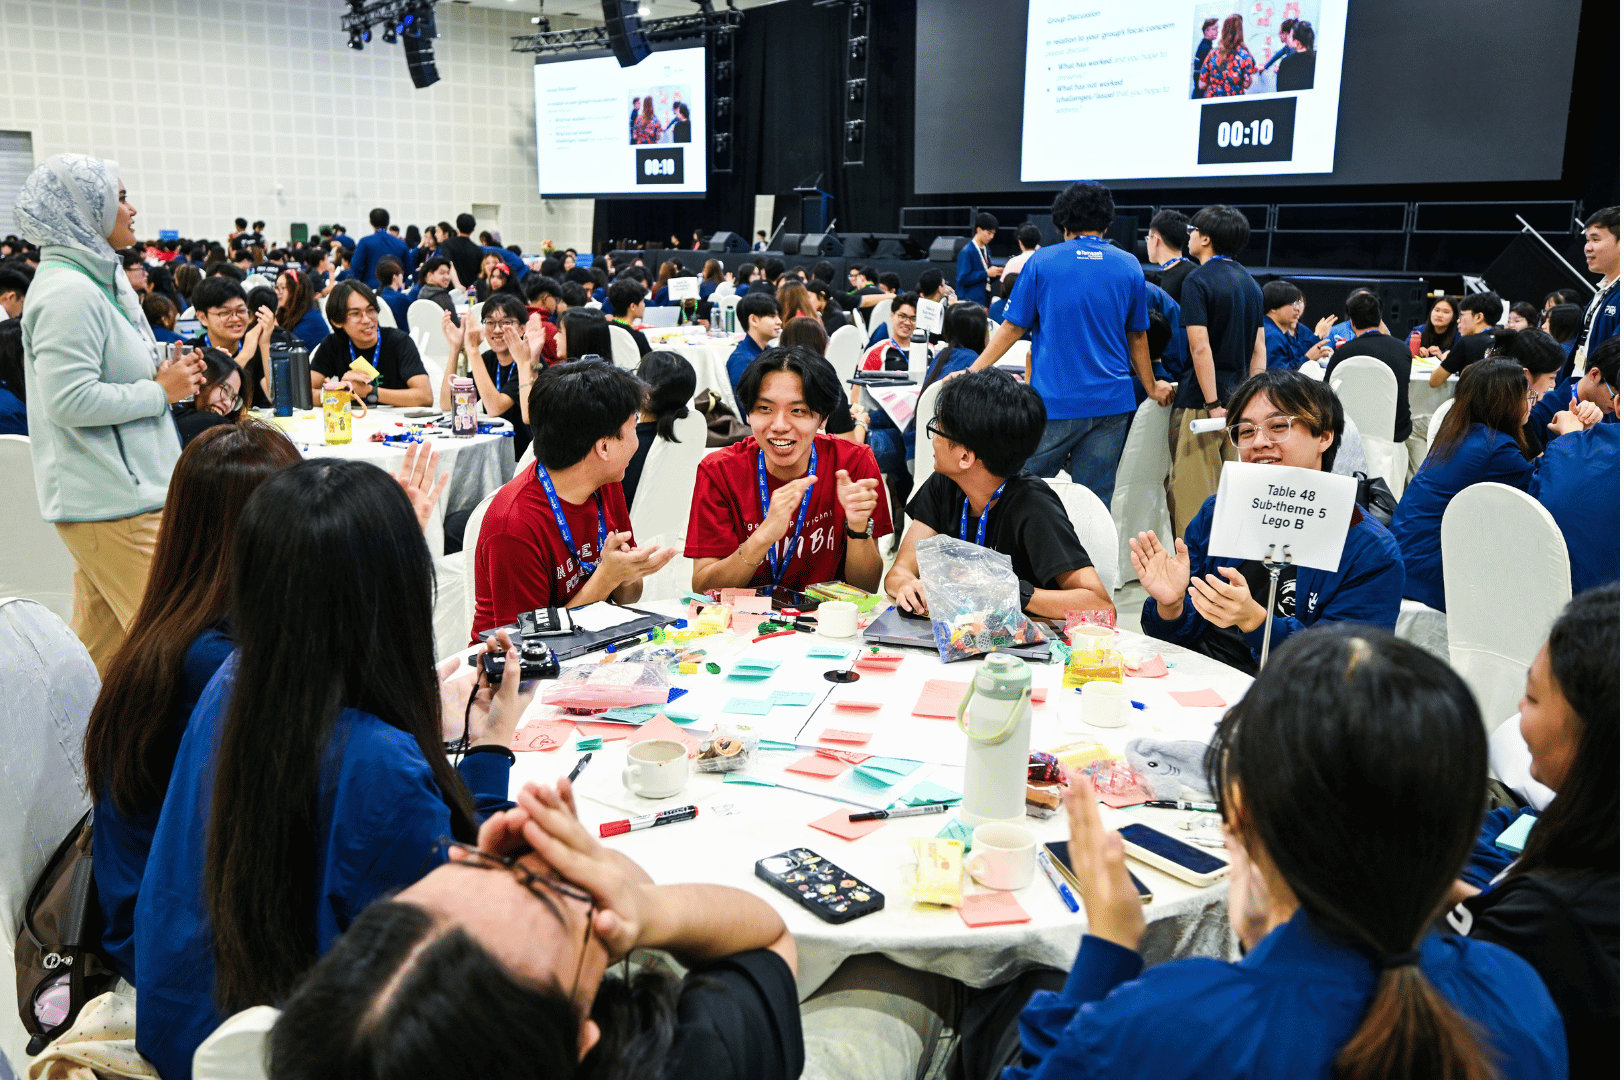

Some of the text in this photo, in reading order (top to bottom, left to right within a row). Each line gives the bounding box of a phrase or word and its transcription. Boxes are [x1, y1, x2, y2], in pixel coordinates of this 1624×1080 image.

[1217, 119, 1274, 147] 00:10
[644, 158, 675, 176] 00:10
[1268, 484, 1316, 501] Table 48
[1251, 498, 1327, 519] Sub-theme 5
[1262, 514, 1305, 530] Lego B
